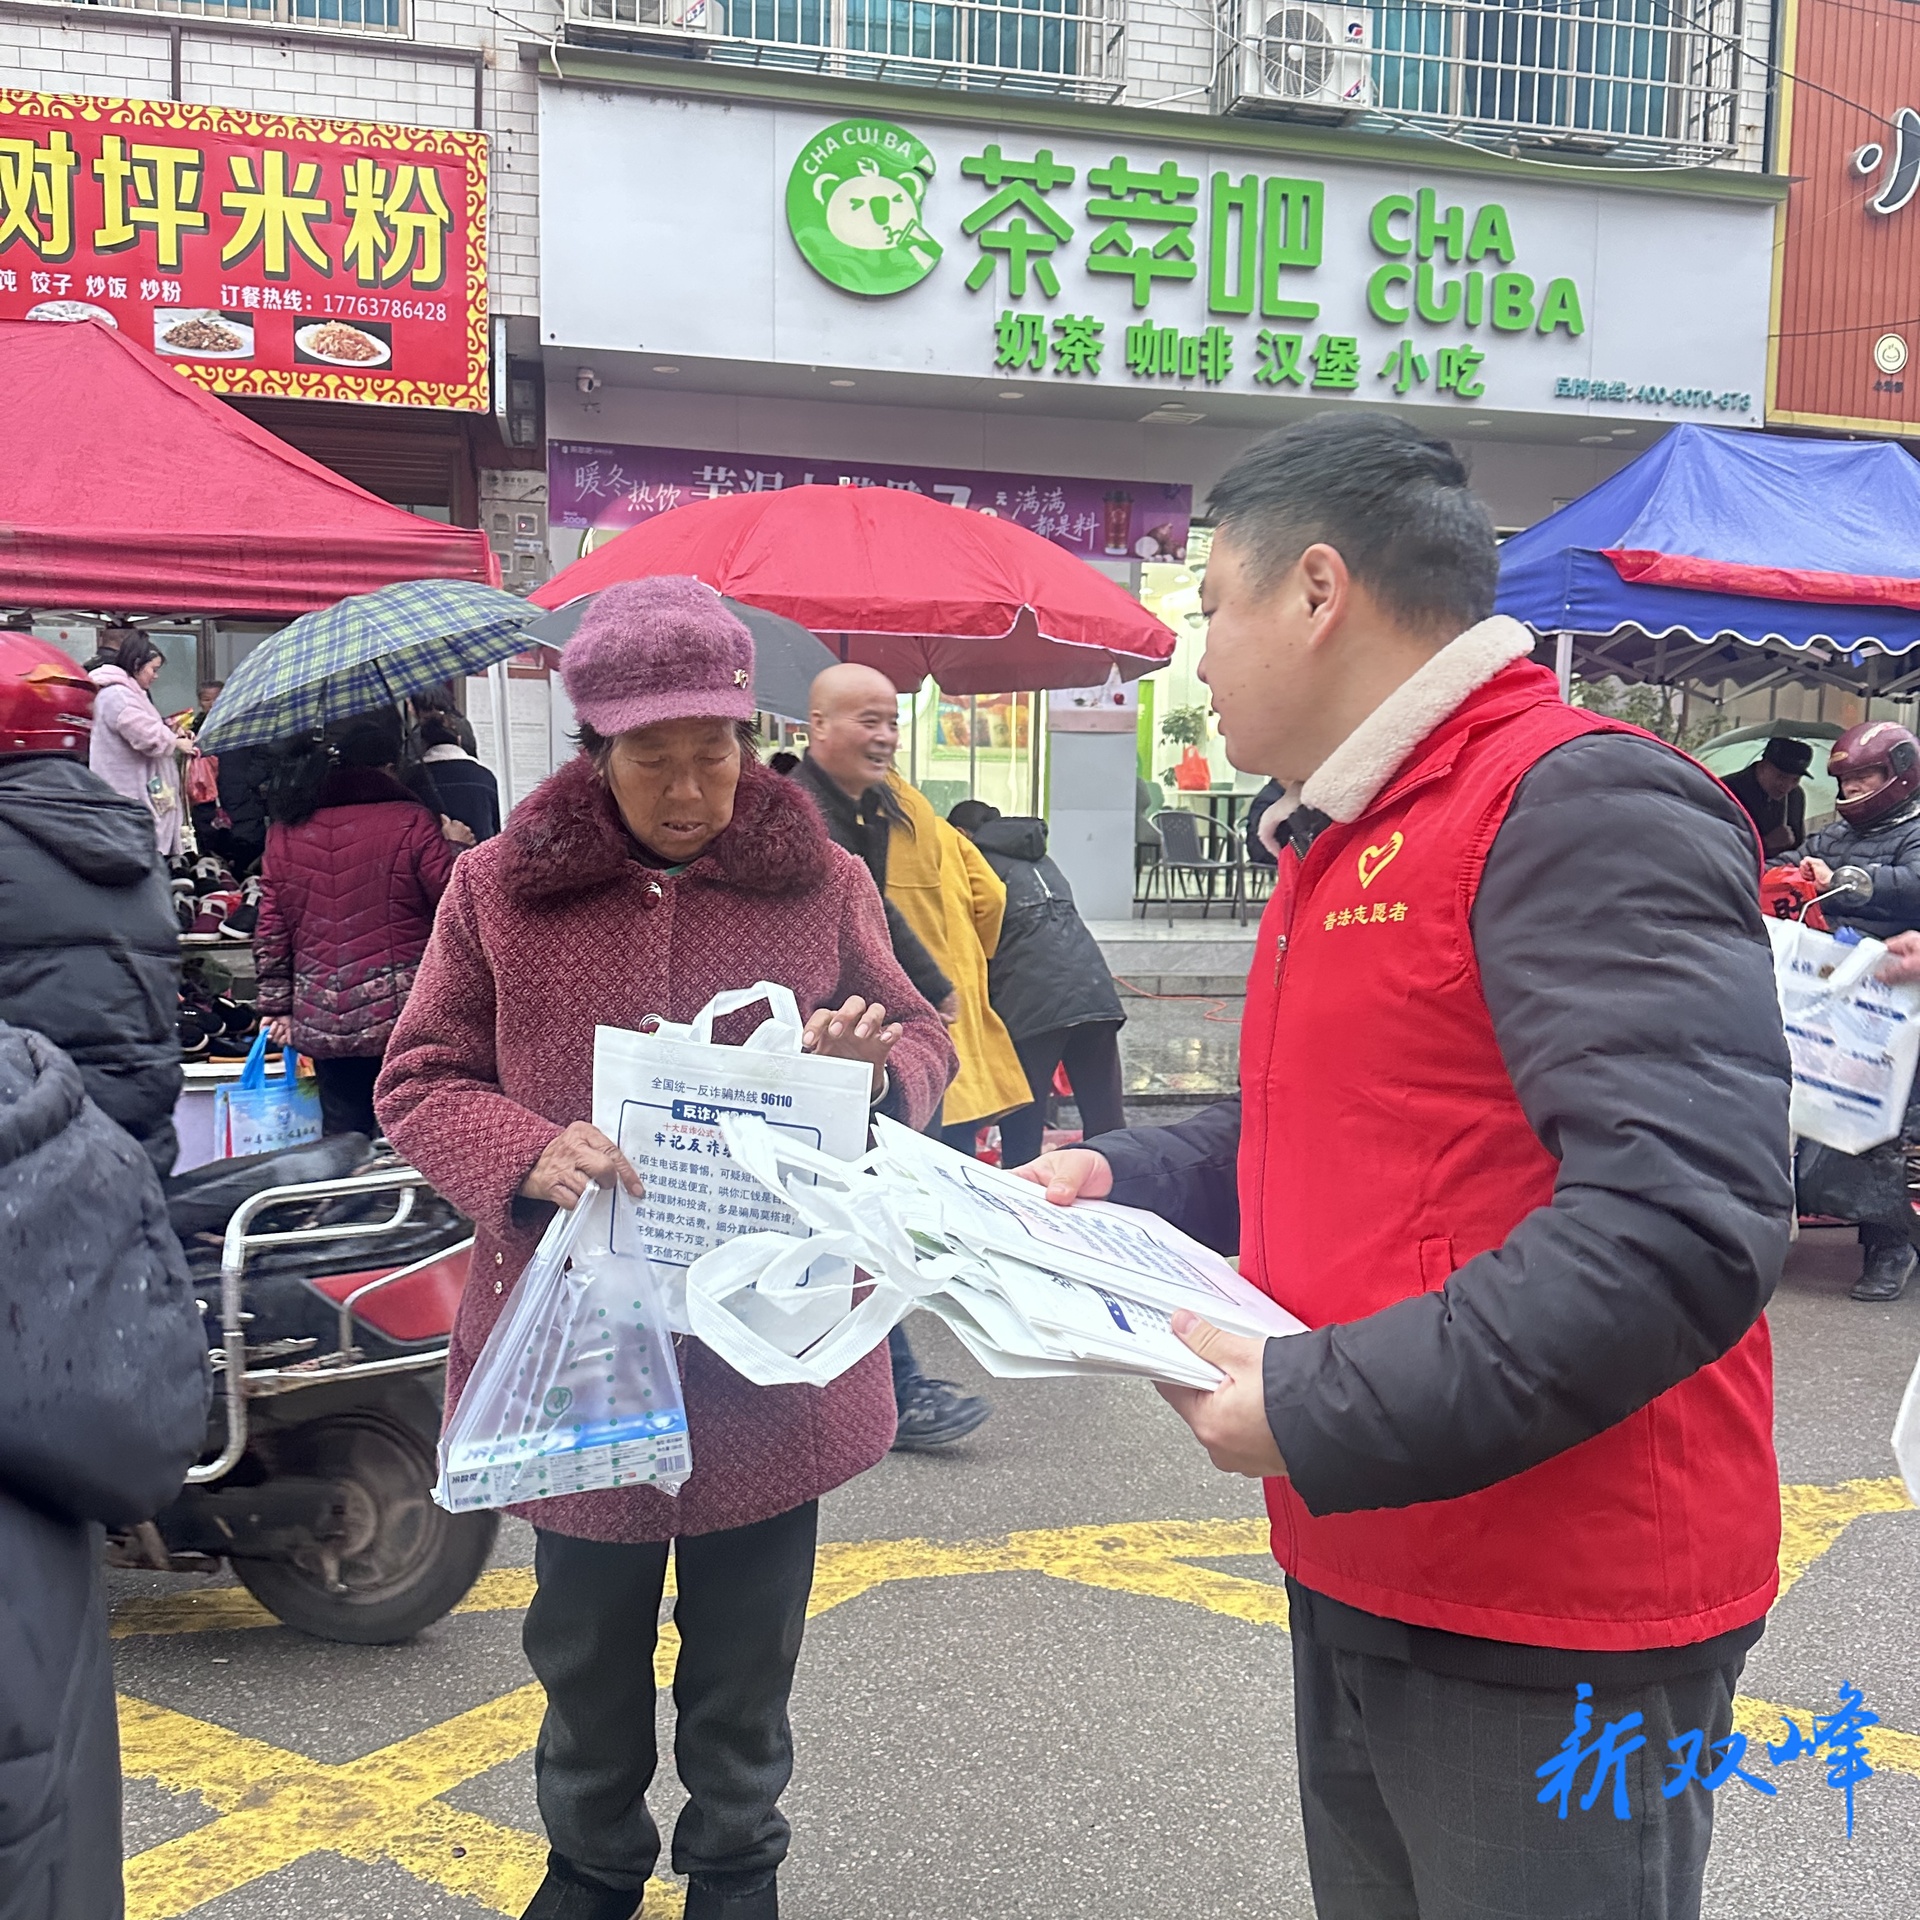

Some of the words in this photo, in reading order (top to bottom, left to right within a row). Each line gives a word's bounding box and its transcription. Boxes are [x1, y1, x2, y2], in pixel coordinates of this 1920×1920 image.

[802, 136, 841, 175] CHA
[842, 126, 879, 145] CUI
[883, 131, 912, 158] BA
[0, 130, 451, 284] 树坪米粉
[1368, 187, 1517, 264] CHA
[960, 143, 1326, 320] 茶萃吧
[30, 271, 73, 296] 饺子
[86, 274, 128, 300] 炒饭
[139, 278, 182, 303] 炒粉
[1366, 263, 1586, 336] CUIBA
[994, 310, 1105, 376] 奶茶
[1125, 318, 1234, 383] 咖啡
[1253, 328, 1361, 391] 汉堡
[1376, 338, 1487, 398] 小吃
[575, 460, 632, 502] 暖冬
[627, 480, 683, 512] 热饮
[562, 515, 588, 525] 2009
[1012, 485, 1066, 520] 满满
[1030, 512, 1101, 550] 都是料
[1323, 902, 1409, 931] 普法志愿者
[651, 1076, 758, 1104] 全国统一反诈骗热线
[760, 1092, 793, 1108] 96110
[662, 1122, 715, 1138] 十大反诈公式
[642, 1189, 797, 1226] 利理财和投资，多是骗局莫搭理；
